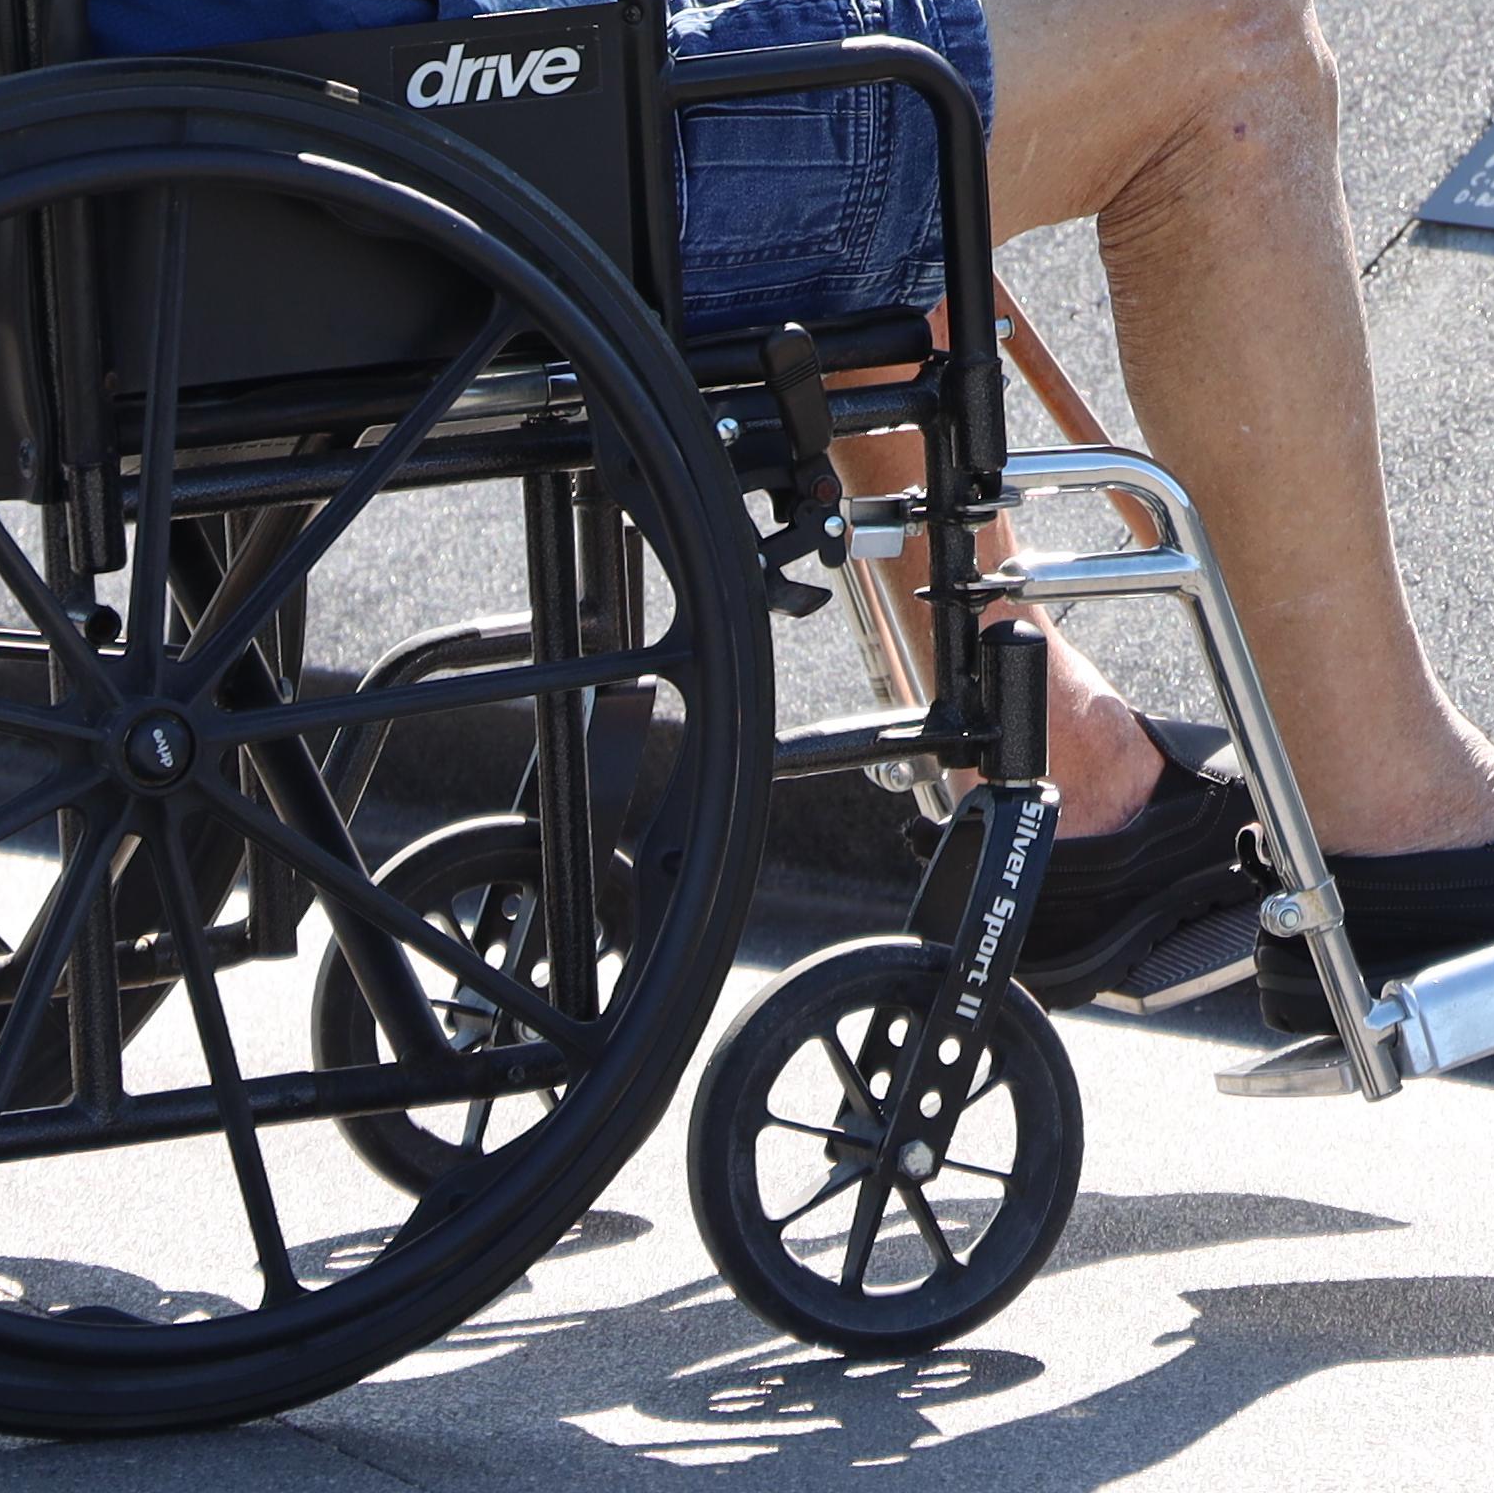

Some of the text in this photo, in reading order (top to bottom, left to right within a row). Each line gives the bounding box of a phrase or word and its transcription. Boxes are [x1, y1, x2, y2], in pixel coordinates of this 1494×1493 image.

[407, 44, 581, 109] drive
[1470, 171, 1487, 186] C
[153, 729, 173, 767] drive
[1002, 800, 1044, 890] Silver
[967, 896, 1016, 987] Sport
